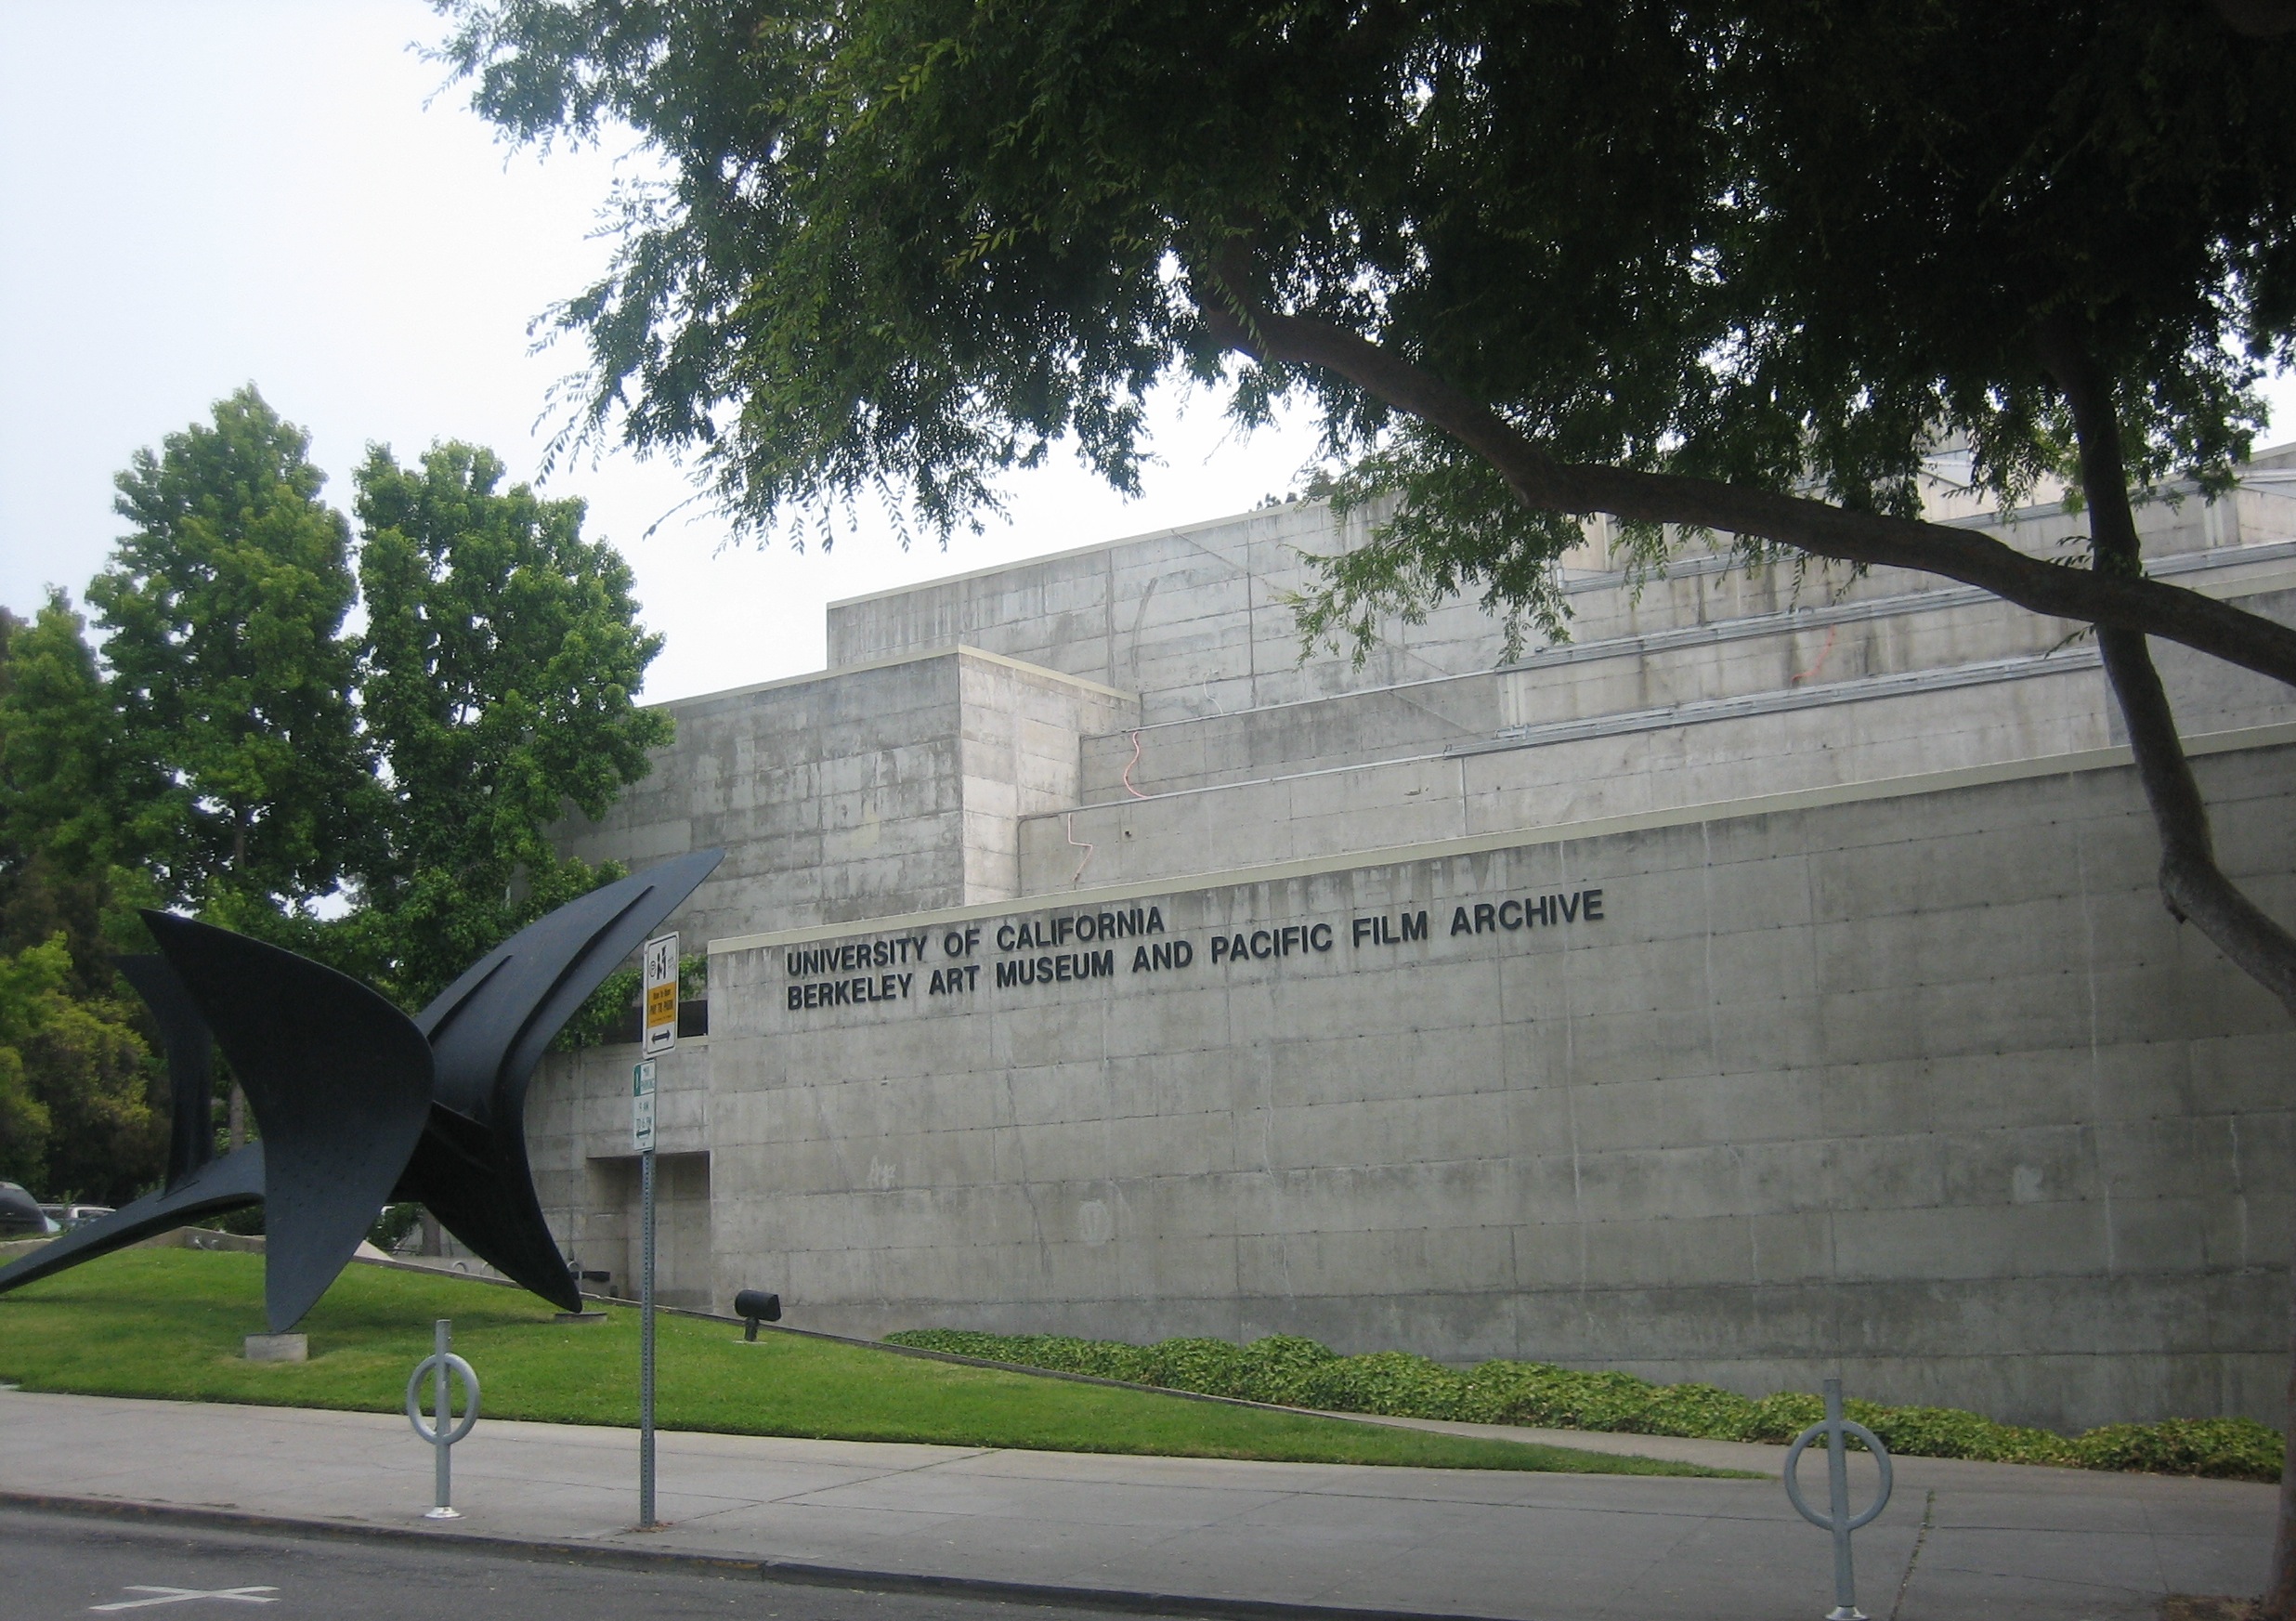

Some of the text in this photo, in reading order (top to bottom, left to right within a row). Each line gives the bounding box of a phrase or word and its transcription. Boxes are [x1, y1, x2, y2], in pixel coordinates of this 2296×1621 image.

[787, 906, 1165, 976] UNIVERSITY OF CALIFORNIA
[788, 888, 1605, 1011] BERKELEY ART MUSEUM AND PACIFIC FILM ARCHIVE
